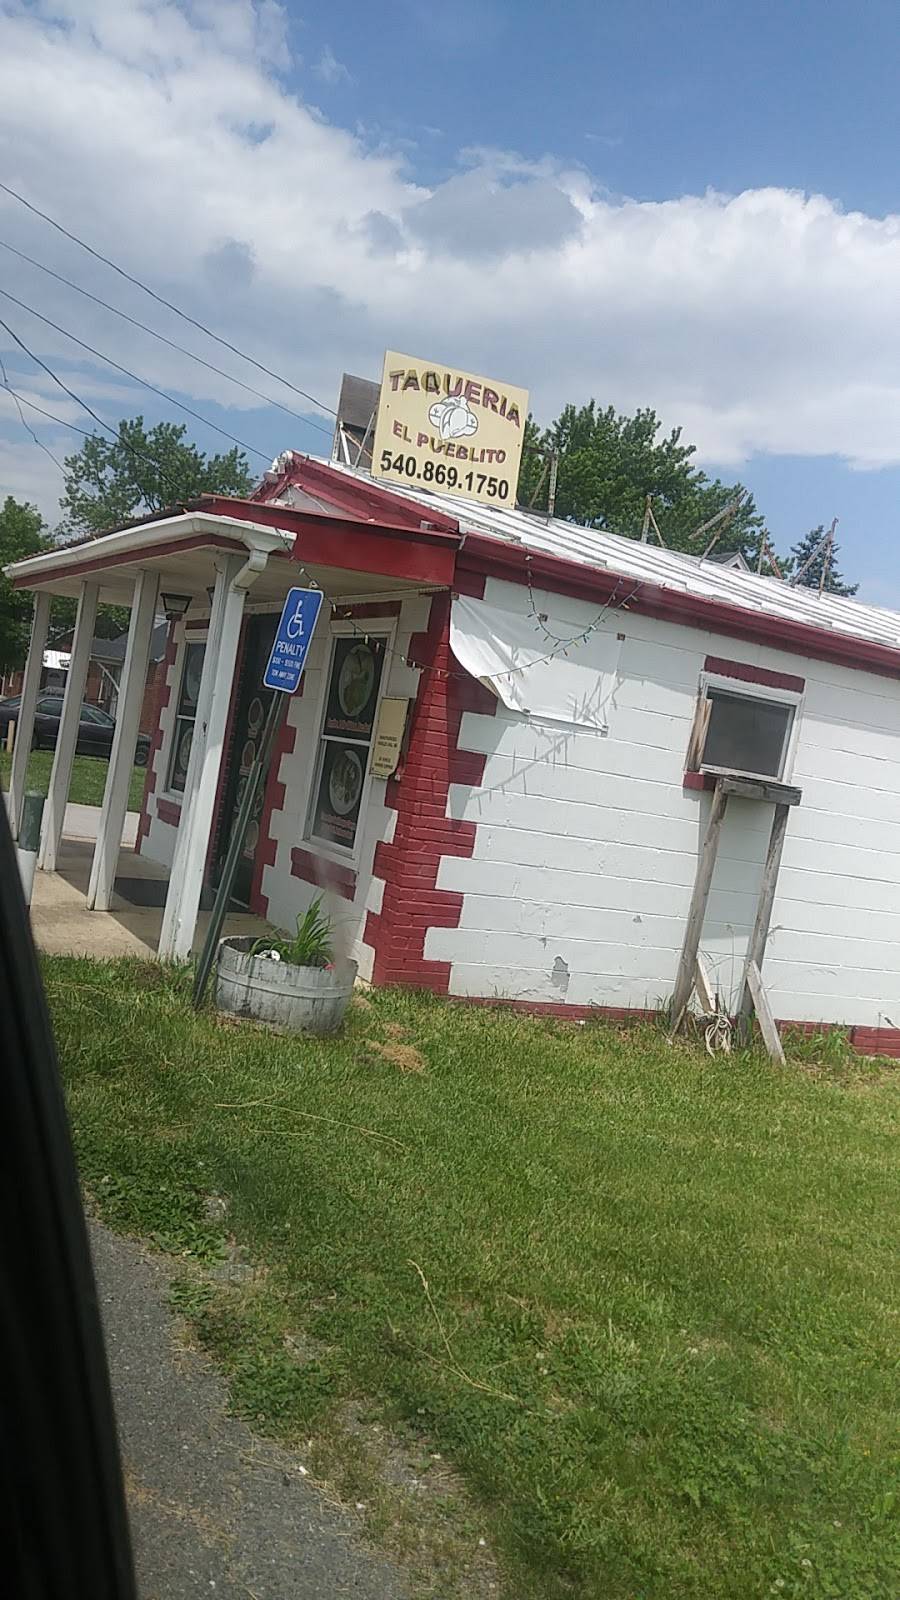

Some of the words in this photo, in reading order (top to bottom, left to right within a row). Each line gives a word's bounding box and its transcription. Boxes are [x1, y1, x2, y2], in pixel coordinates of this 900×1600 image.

[389, 369, 521, 429] TAQUERIA
[392, 420, 412, 443] EL
[416, 432, 507, 464] PUEBLITO
[380, 449, 509, 500] 540.869.1750
[275, 640, 306, 657] PENALTY
